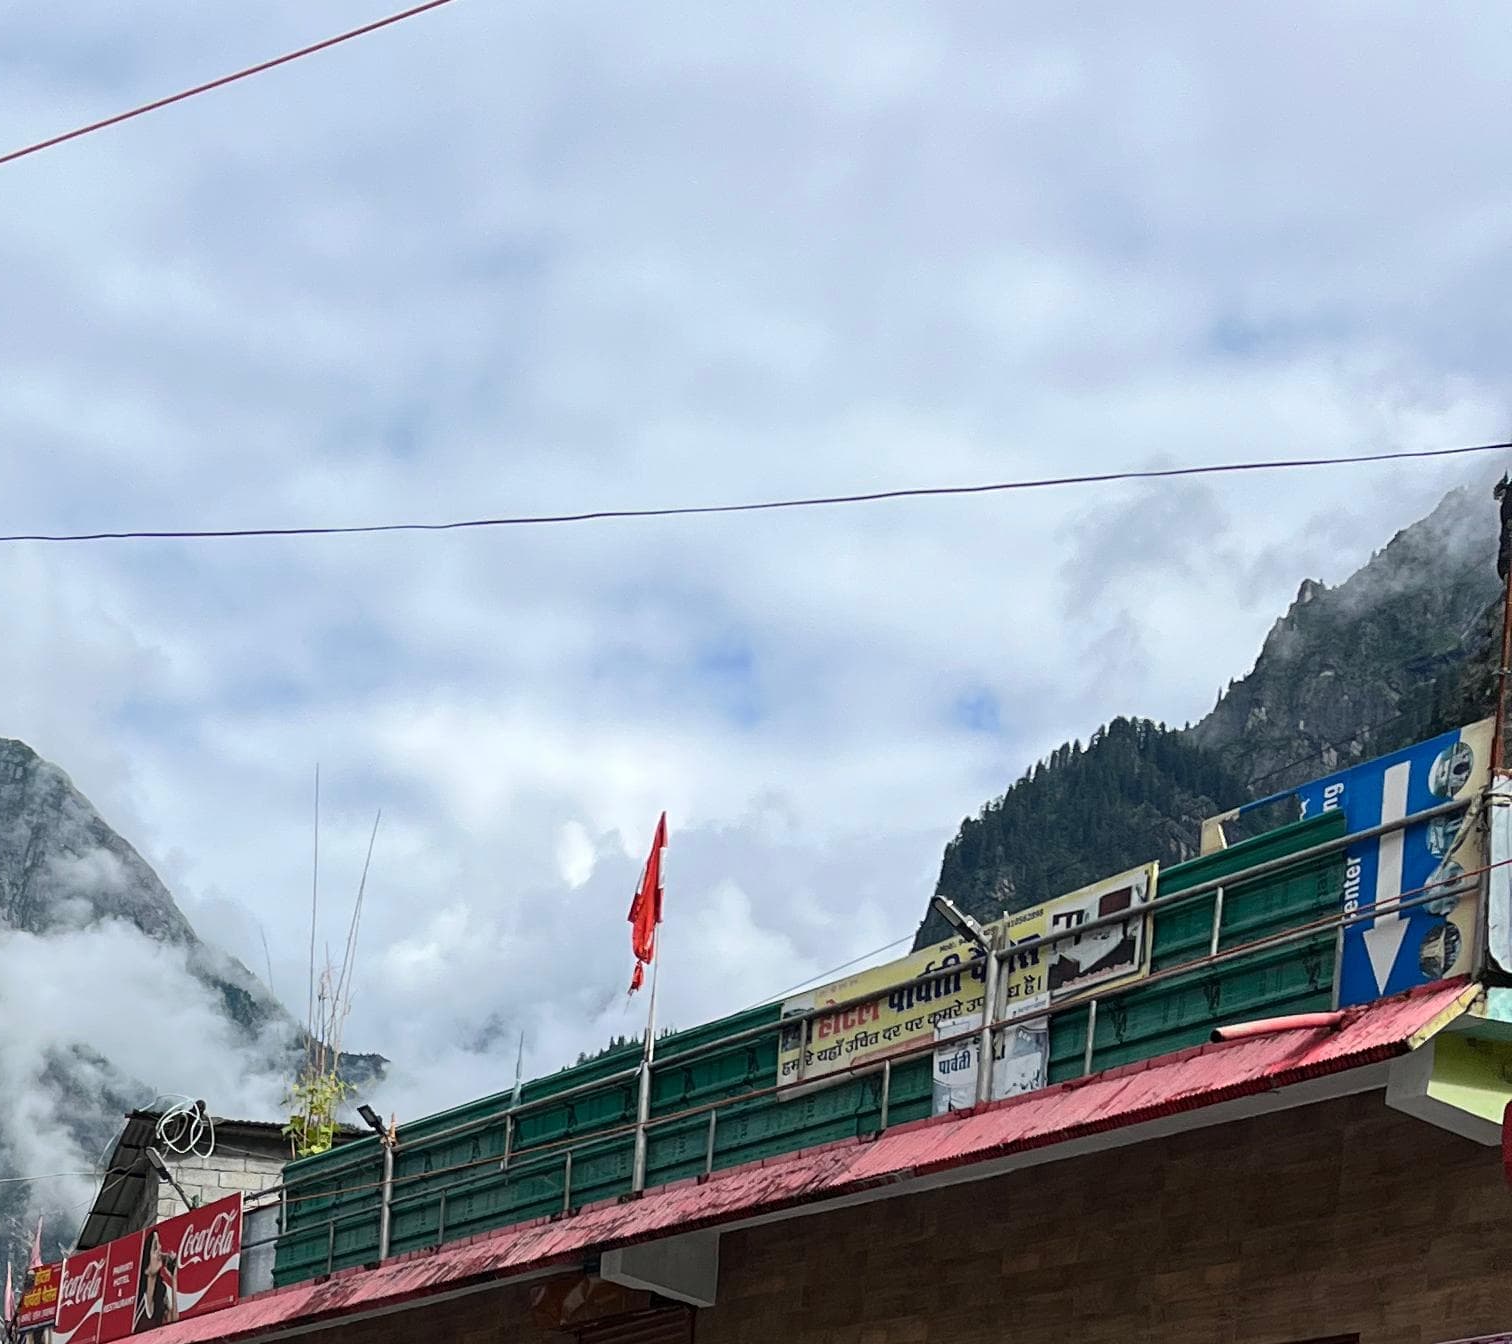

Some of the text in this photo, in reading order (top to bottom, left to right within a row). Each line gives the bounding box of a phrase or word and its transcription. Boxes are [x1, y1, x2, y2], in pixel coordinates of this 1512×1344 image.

[905, 1016, 924, 1031] पर
[939, 1050, 970, 1075] पार्वती
[177, 1209, 238, 1269] Coca-Cola
